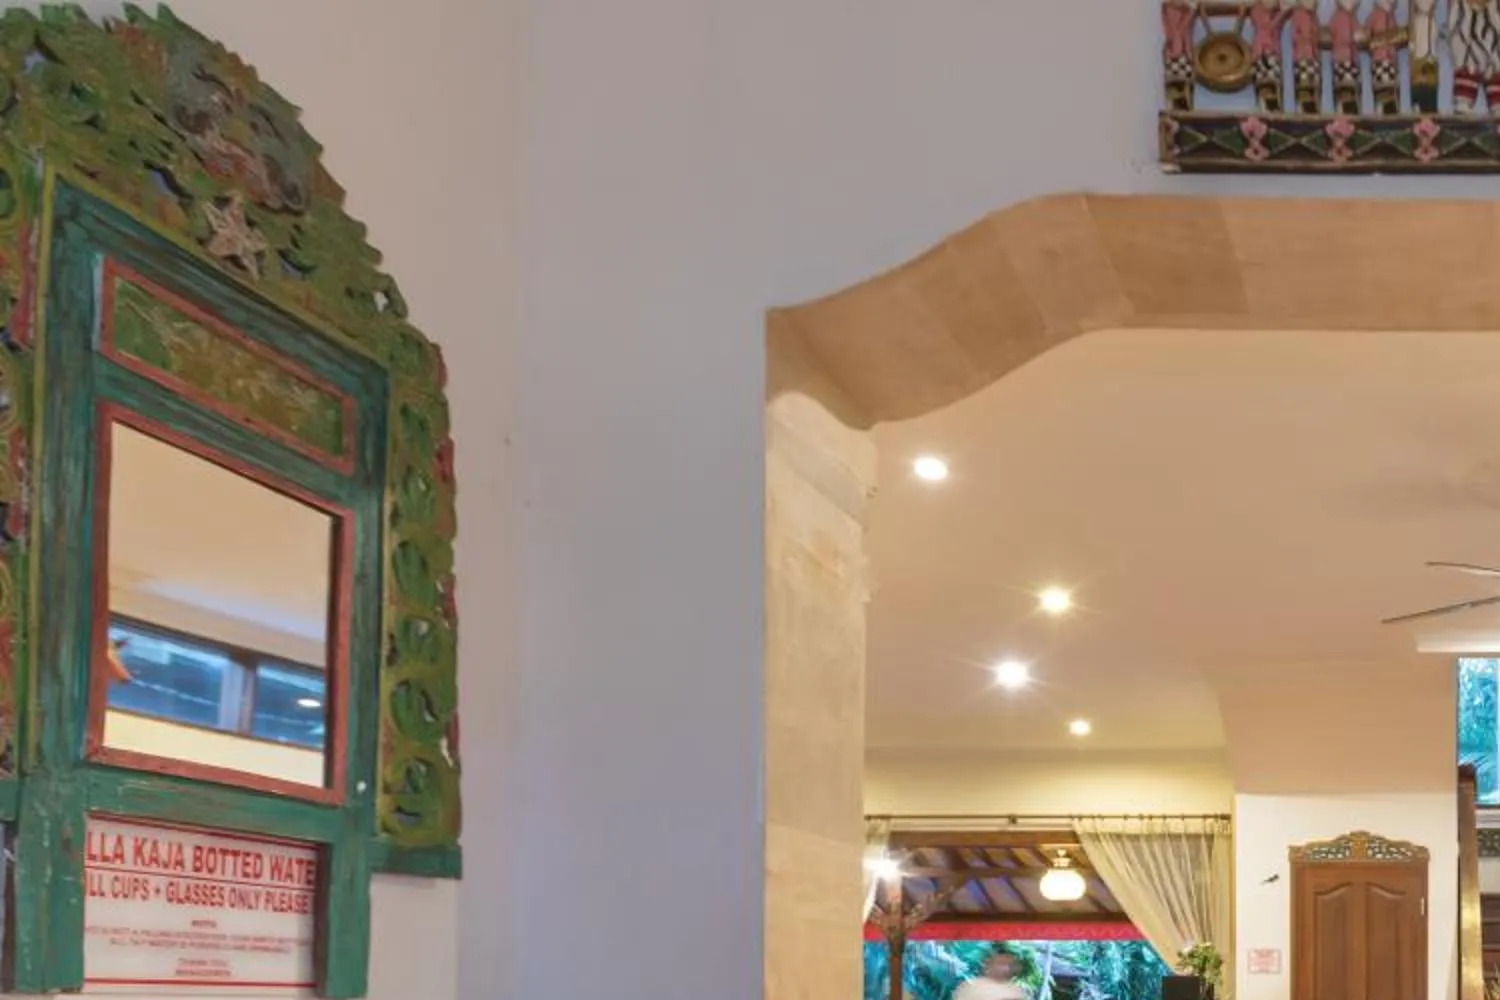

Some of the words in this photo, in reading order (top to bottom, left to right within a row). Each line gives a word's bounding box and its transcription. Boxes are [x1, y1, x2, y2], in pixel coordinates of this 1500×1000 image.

[87, 831, 125, 864] LLA
[133, 836, 185, 872] KAJA
[193, 845, 263, 879] BOTTED
[269, 855, 315, 886] WATE
